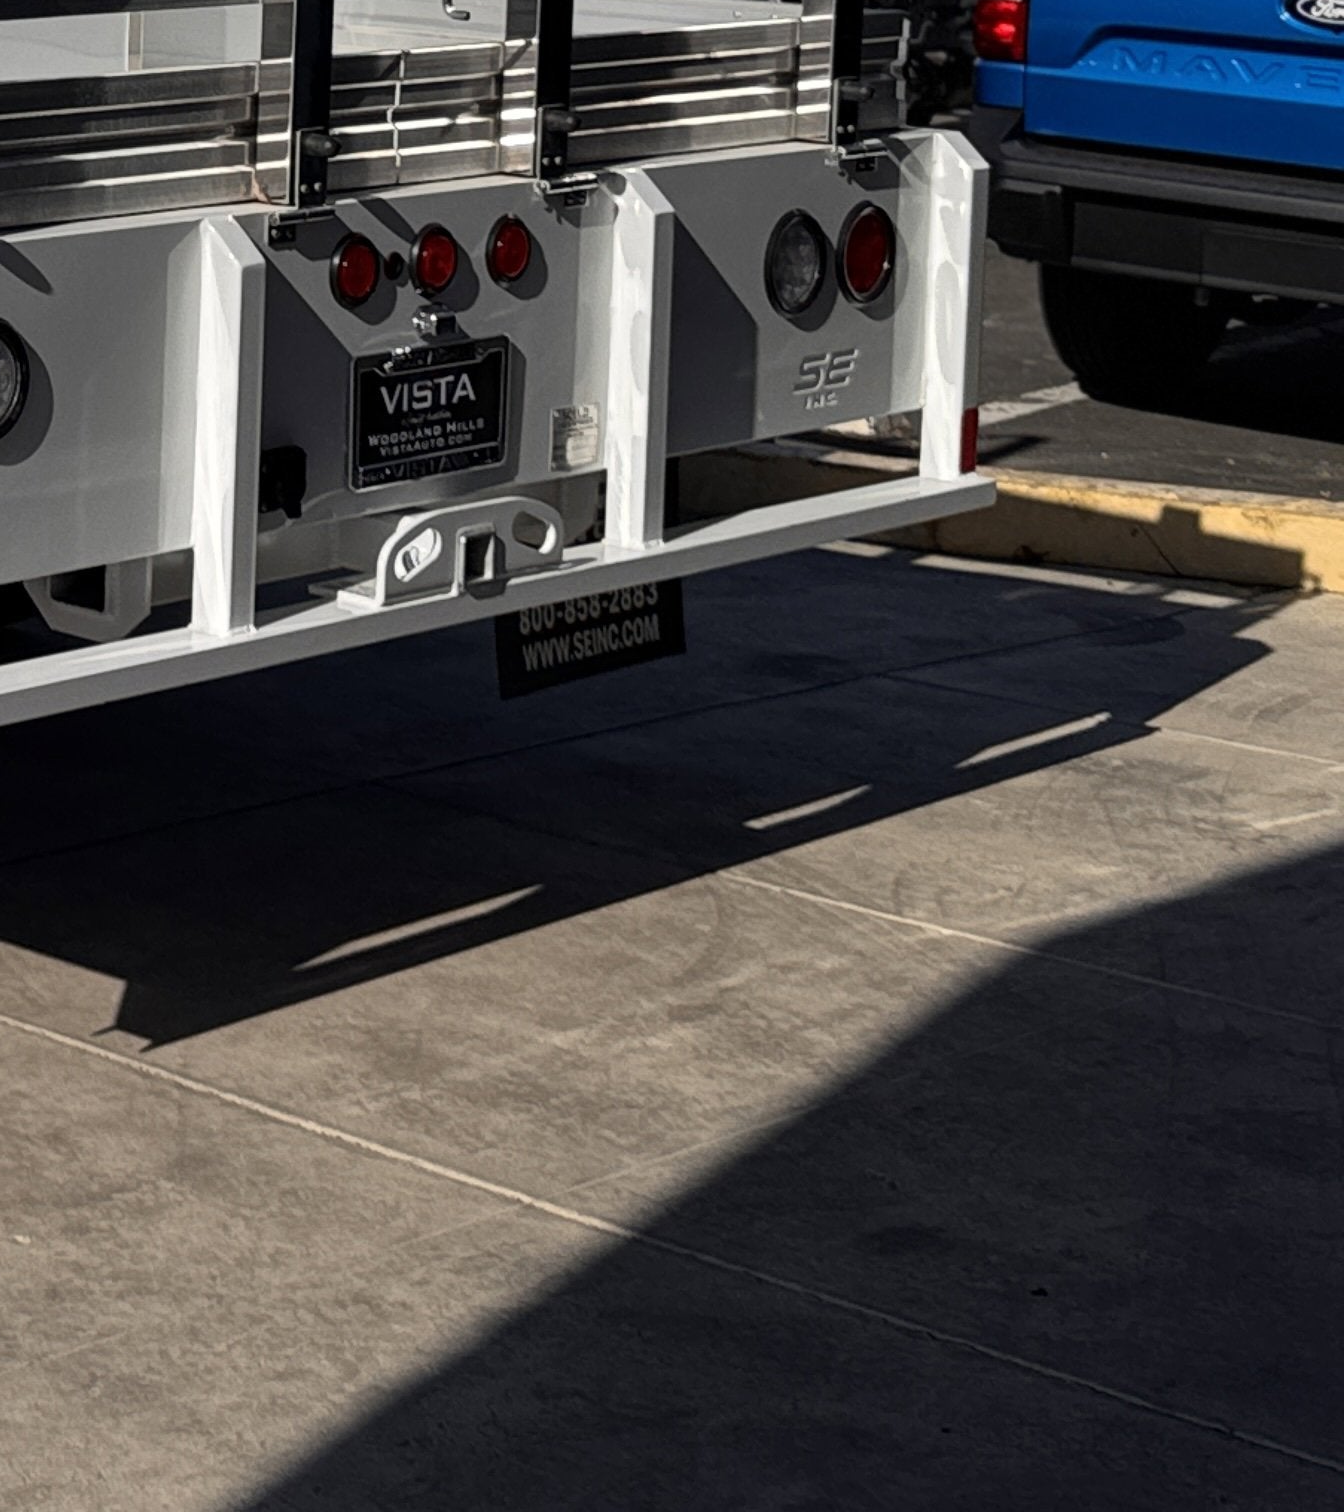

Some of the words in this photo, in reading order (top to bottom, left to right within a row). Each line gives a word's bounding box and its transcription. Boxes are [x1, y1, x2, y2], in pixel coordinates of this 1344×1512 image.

[380, 372, 476, 415] VISTA
[367, 425, 443, 448] WOODLAND
[446, 417, 485, 433] HILLS
[522, 613, 661, 673] WWW.SEINC.COM
